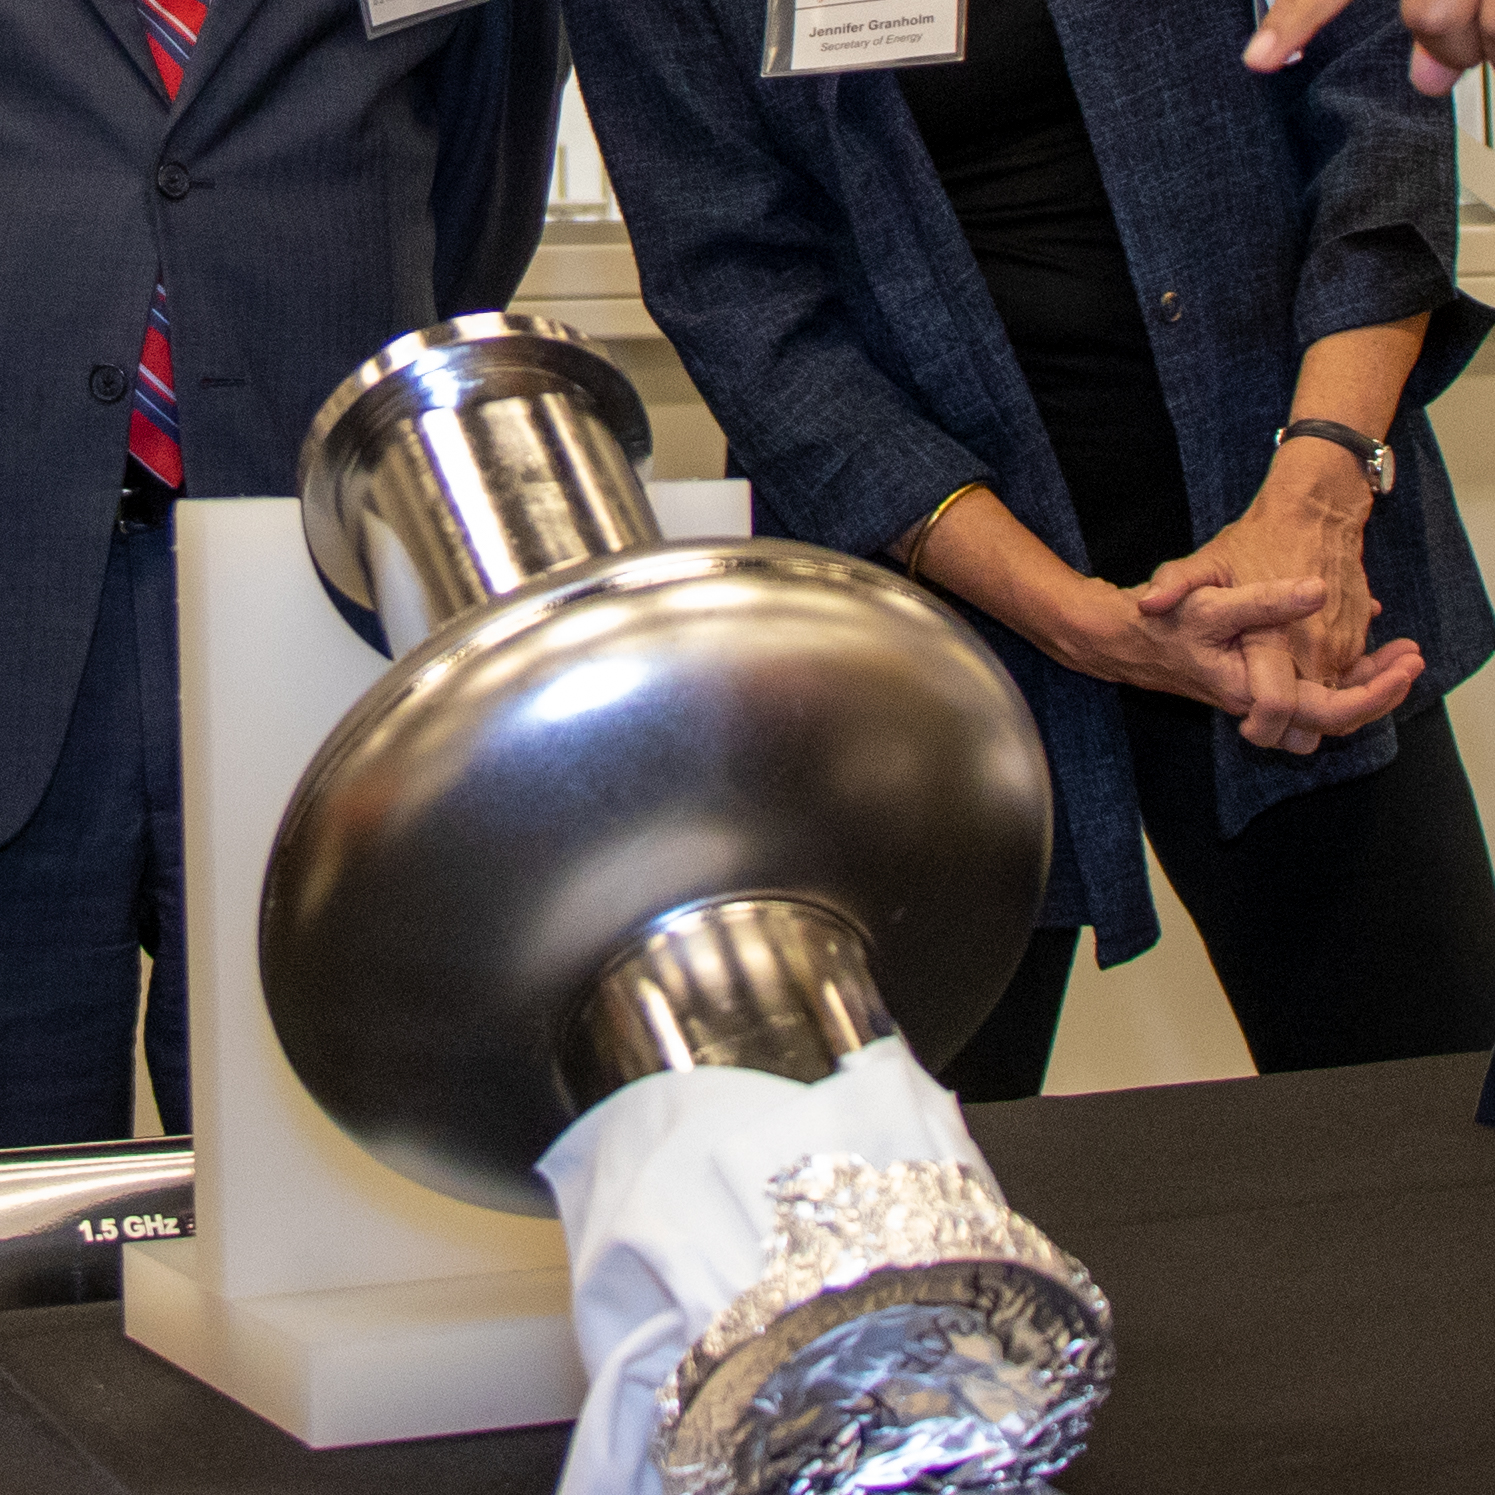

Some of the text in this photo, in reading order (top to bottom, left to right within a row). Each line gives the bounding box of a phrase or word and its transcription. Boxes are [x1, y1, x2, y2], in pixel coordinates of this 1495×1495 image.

[809, 14, 935, 38] Jennifer Granholm
[820, 32, 923, 53] Secretary of Energy
[78, 1217, 119, 1243] 1.5
[123, 1213, 180, 1238] GHz
